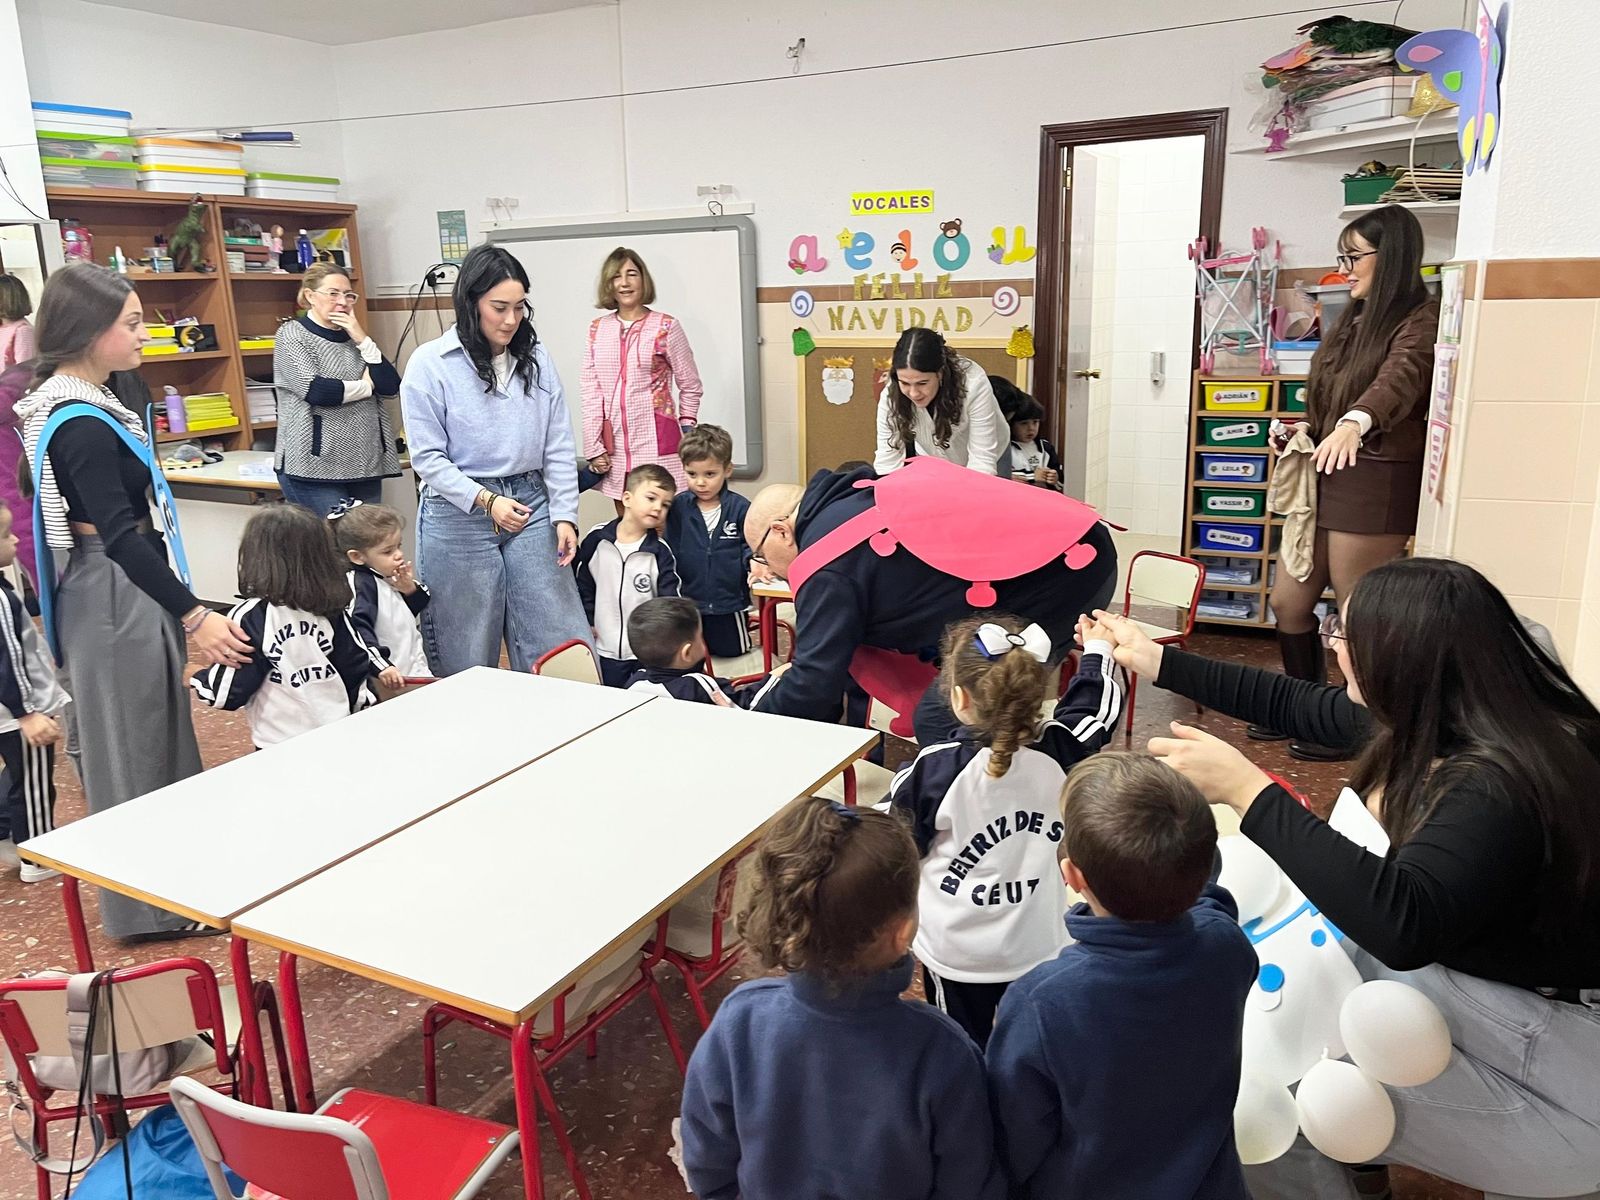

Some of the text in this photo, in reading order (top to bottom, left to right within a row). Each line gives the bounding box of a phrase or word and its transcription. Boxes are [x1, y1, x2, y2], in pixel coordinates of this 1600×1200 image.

[852, 195, 930, 211] VOCALES
[853, 272, 953, 300] FELIZ
[827, 305, 973, 333] NAVIDAD
[1222, 464, 1240, 472] LEILA
[1015, 810, 1045, 835] DE
[1046, 821, 1064, 843] S
[971, 878, 1040, 906] CEUT
